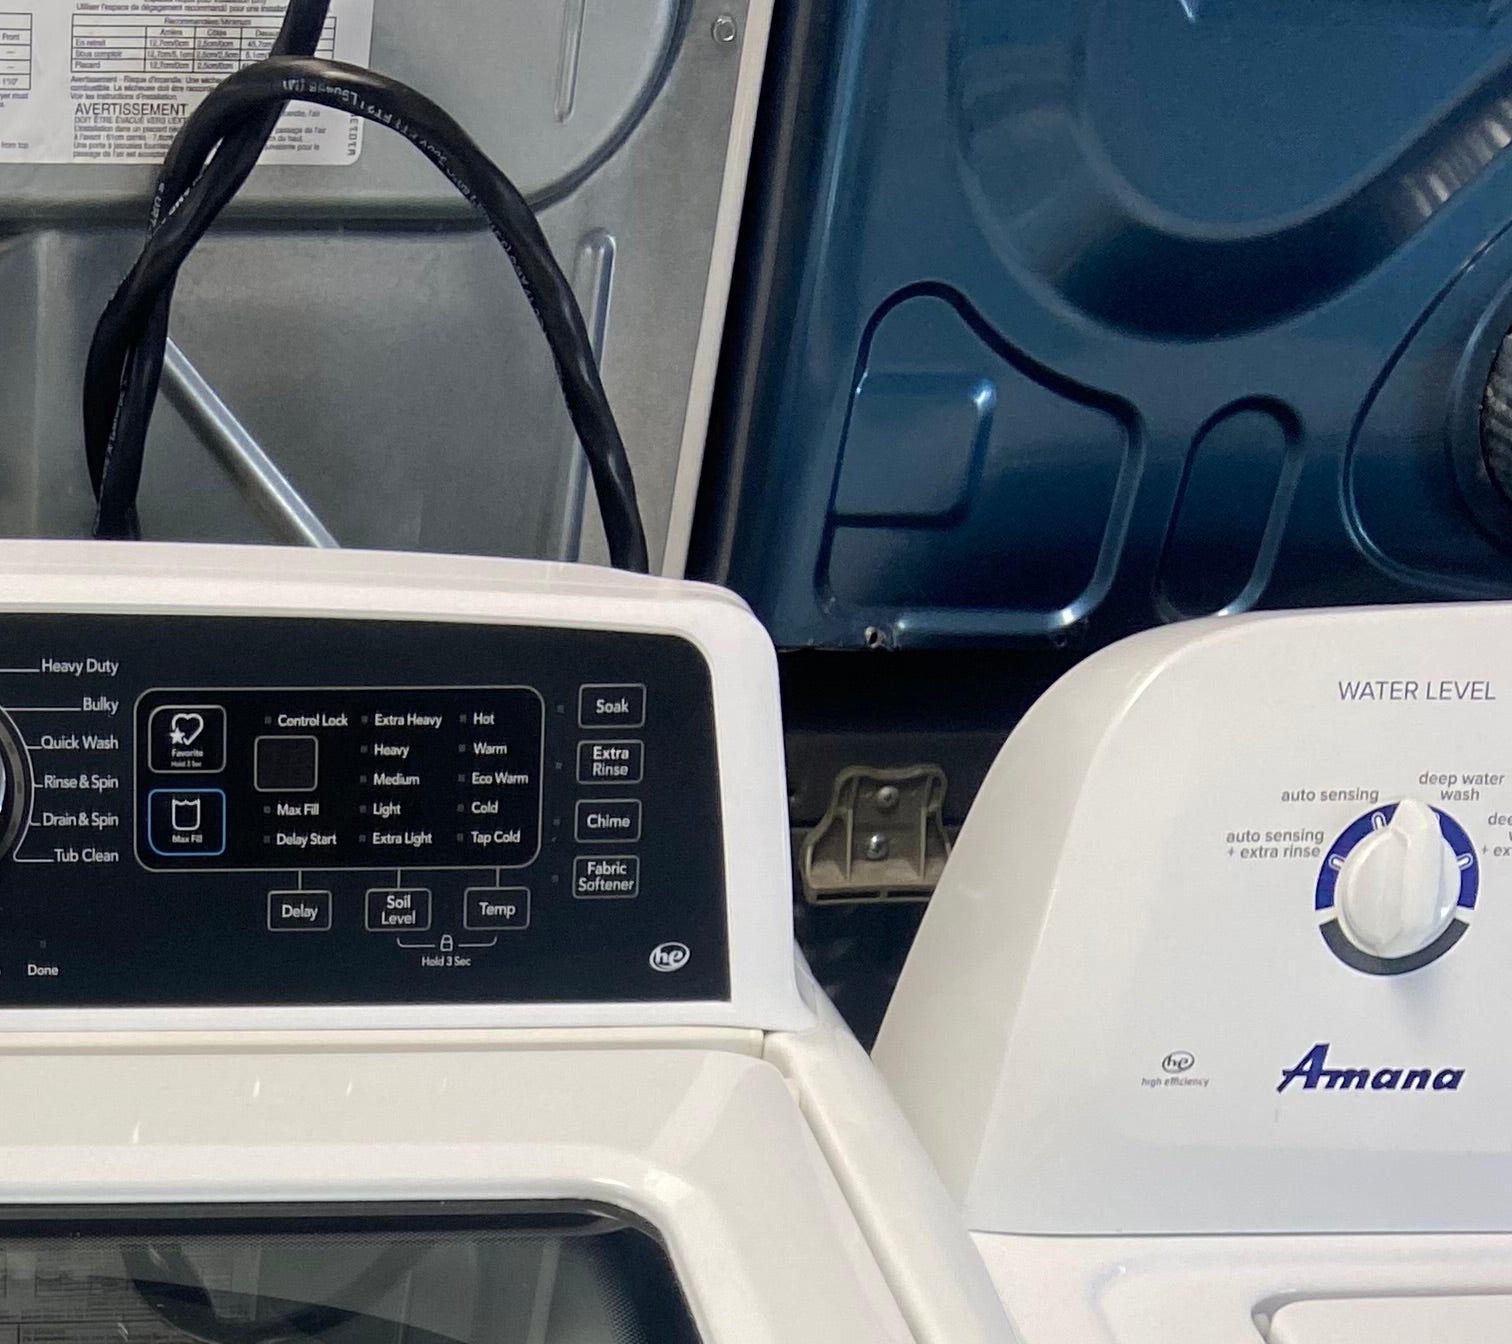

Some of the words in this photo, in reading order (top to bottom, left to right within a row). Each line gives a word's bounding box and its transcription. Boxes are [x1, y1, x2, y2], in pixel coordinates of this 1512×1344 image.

[74, 103, 189, 116] AVERTISSEMENT
[347, 113, 359, 156] W1013
[42, 659, 83, 676] Heavy
[86, 659, 119, 676] Duty
[1338, 681, 1418, 700] WATER
[1426, 681, 1496, 700] LEVEL
[82, 698, 119, 714] Bulky
[596, 699, 630, 714] Soak
[278, 713, 320, 727] Control
[322, 713, 348, 727] Lock
[374, 713, 403, 727] Extra
[406, 713, 443, 730] Heavy
[473, 711, 495, 726] Hot
[41, 736, 79, 752] Quick
[81, 736, 119, 750] Wash
[374, 743, 409, 758] Heavy
[474, 742, 507, 755] Warm
[593, 746, 629, 761] Extra
[593, 762, 628, 777] Rinse
[44, 775, 76, 789] Rinse
[78, 776, 90, 789] &
[91, 775, 119, 792] Spin
[374, 773, 420, 787] Medium
[472, 773, 495, 786] Eco
[497, 773, 529, 786] Warm
[1419, 771, 1457, 788] deep
[1462, 773, 1506, 786] water
[1281, 789, 1316, 801] auto
[1320, 787, 1380, 804] sensing
[1440, 787, 1480, 800] wash
[276, 803, 301, 817] Max
[304, 803, 320, 816] Fill
[373, 801, 402, 818] Light
[472, 801, 498, 815] Cold
[43, 812, 77, 828] Drain
[79, 813, 90, 827] &
[91, 812, 119, 829] Spin
[587, 813, 631, 828] Chime
[172, 833, 189, 843] Max
[191, 833, 203, 843] Fill
[276, 833, 308, 849] Delay
[309, 832, 337, 846] Start
[373, 831, 403, 846] Extra
[405, 831, 433, 847] Light
[472, 831, 491, 847] Tap
[493, 830, 521, 844] Cold
[1226, 830, 1260, 843] auto
[1265, 828, 1325, 846] sensing
[54, 848, 79, 862] Tub
[82, 848, 119, 862] Clean
[1240, 845, 1280, 859] extra
[1283, 844, 1322, 858] rinse
[587, 860, 628, 876] Fabric
[578, 877, 635, 892] Softener
[386, 895, 412, 910] Soil
[281, 903, 319, 922] Delay
[479, 902, 517, 919] Temp
[381, 911, 417, 926] Level
[422, 954, 444, 968] Hold
[446, 955, 453, 967] 3
[454, 955, 471, 967] Sec
[27, 963, 59, 977] Done
[1276, 1042, 1465, 1093] Amana
[1141, 1077, 1162, 1088] high
[1164, 1077, 1209, 1088] efficiency
